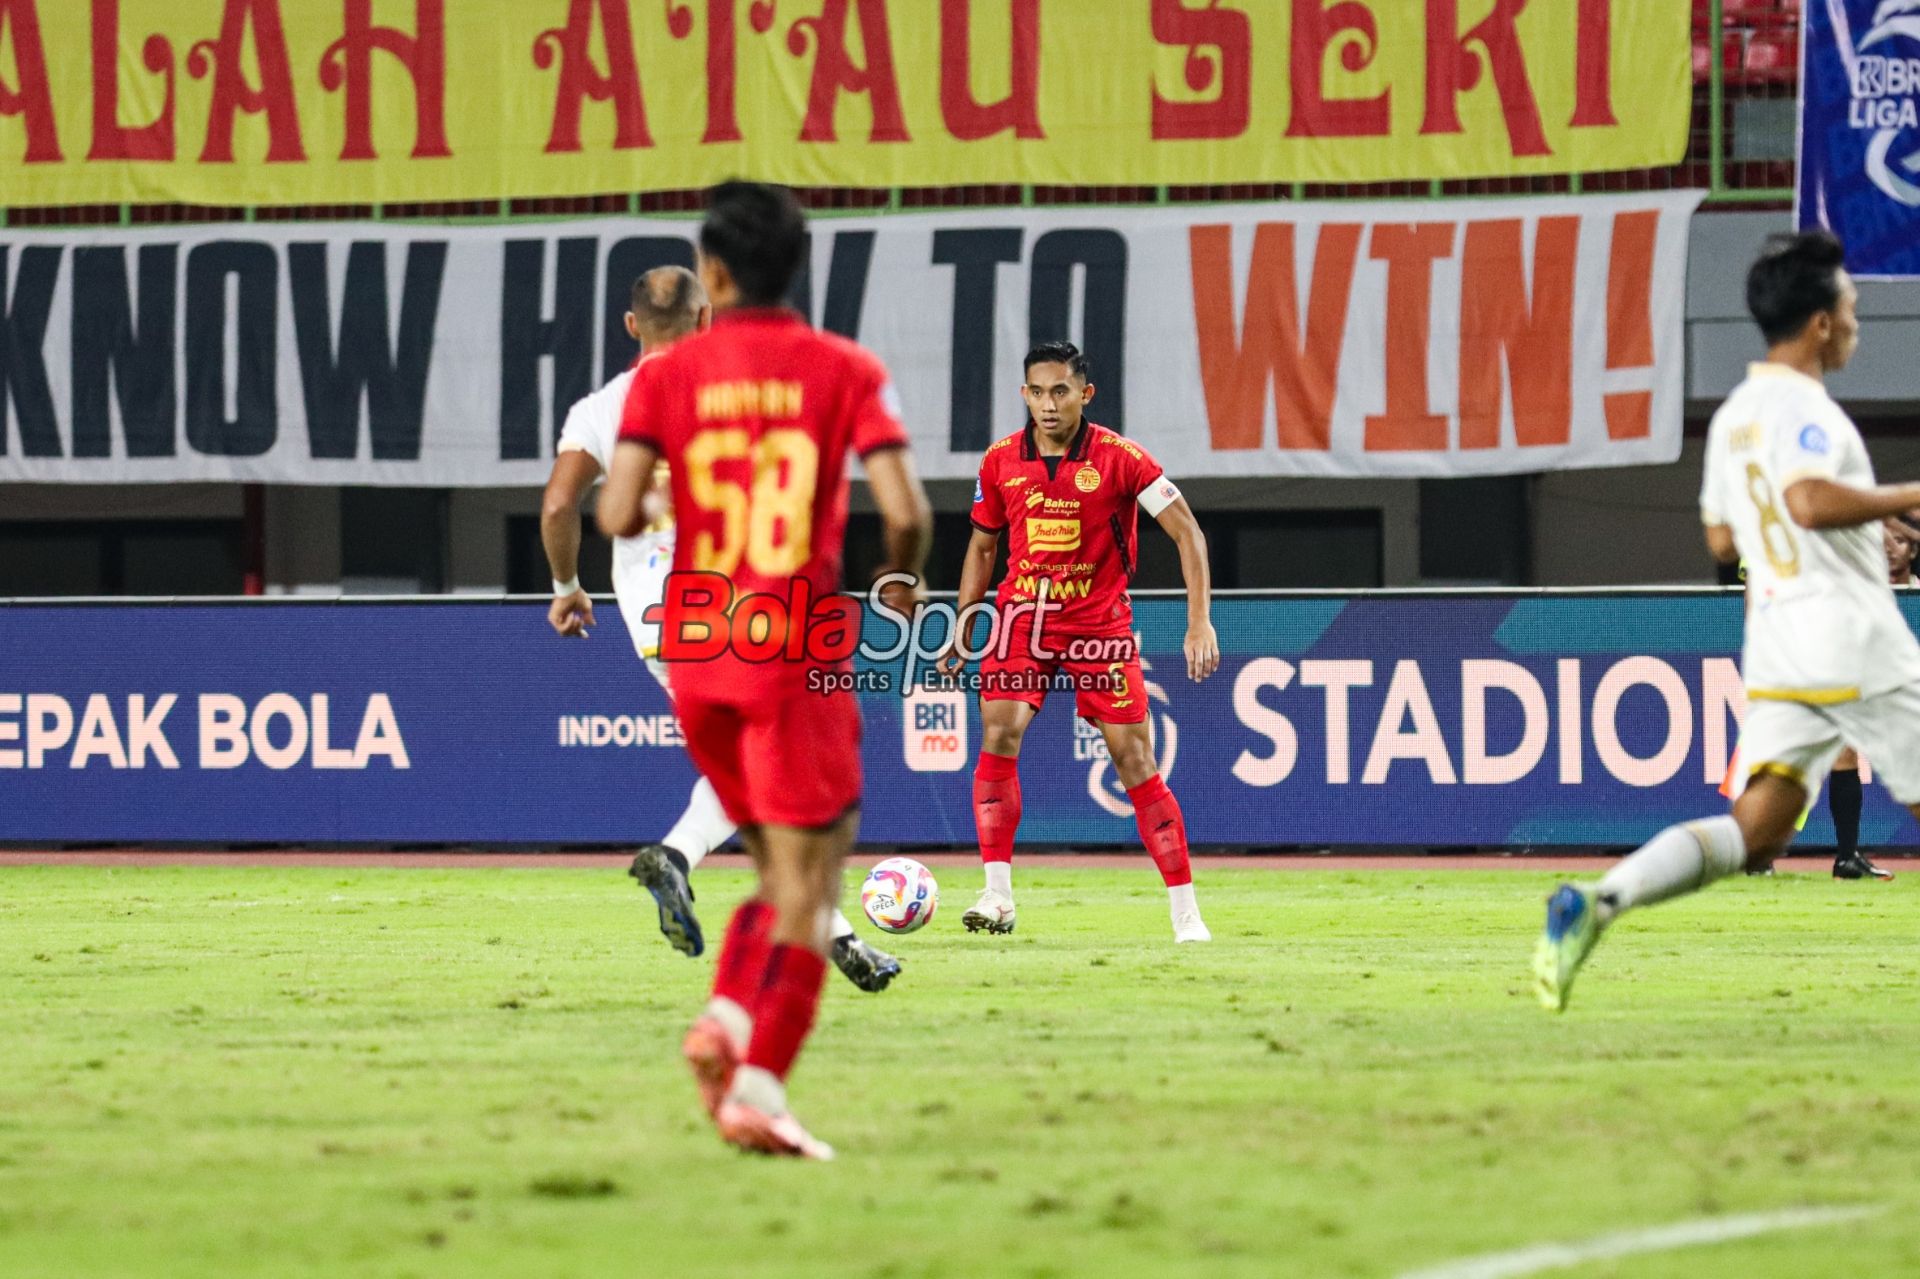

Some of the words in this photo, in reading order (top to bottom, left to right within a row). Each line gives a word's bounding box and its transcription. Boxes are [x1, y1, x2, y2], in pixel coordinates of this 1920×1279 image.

[533, 0, 1047, 152] ATAU
[1151, 0, 1619, 156] SERI
[1849, 98, 1918, 129] LIGA
[0, 240, 449, 460] KNOW
[502, 230, 876, 460] HO
[932, 228, 1128, 452] TO
[1189, 209, 1660, 452] WIN!
[685, 427, 820, 580] 58
[199, 693, 411, 769] BOLA
[914, 703, 956, 731] BRI
[921, 735, 959, 753] mo
[1074, 738, 1112, 762] LIG
[872, 899, 896, 912] SPECS
